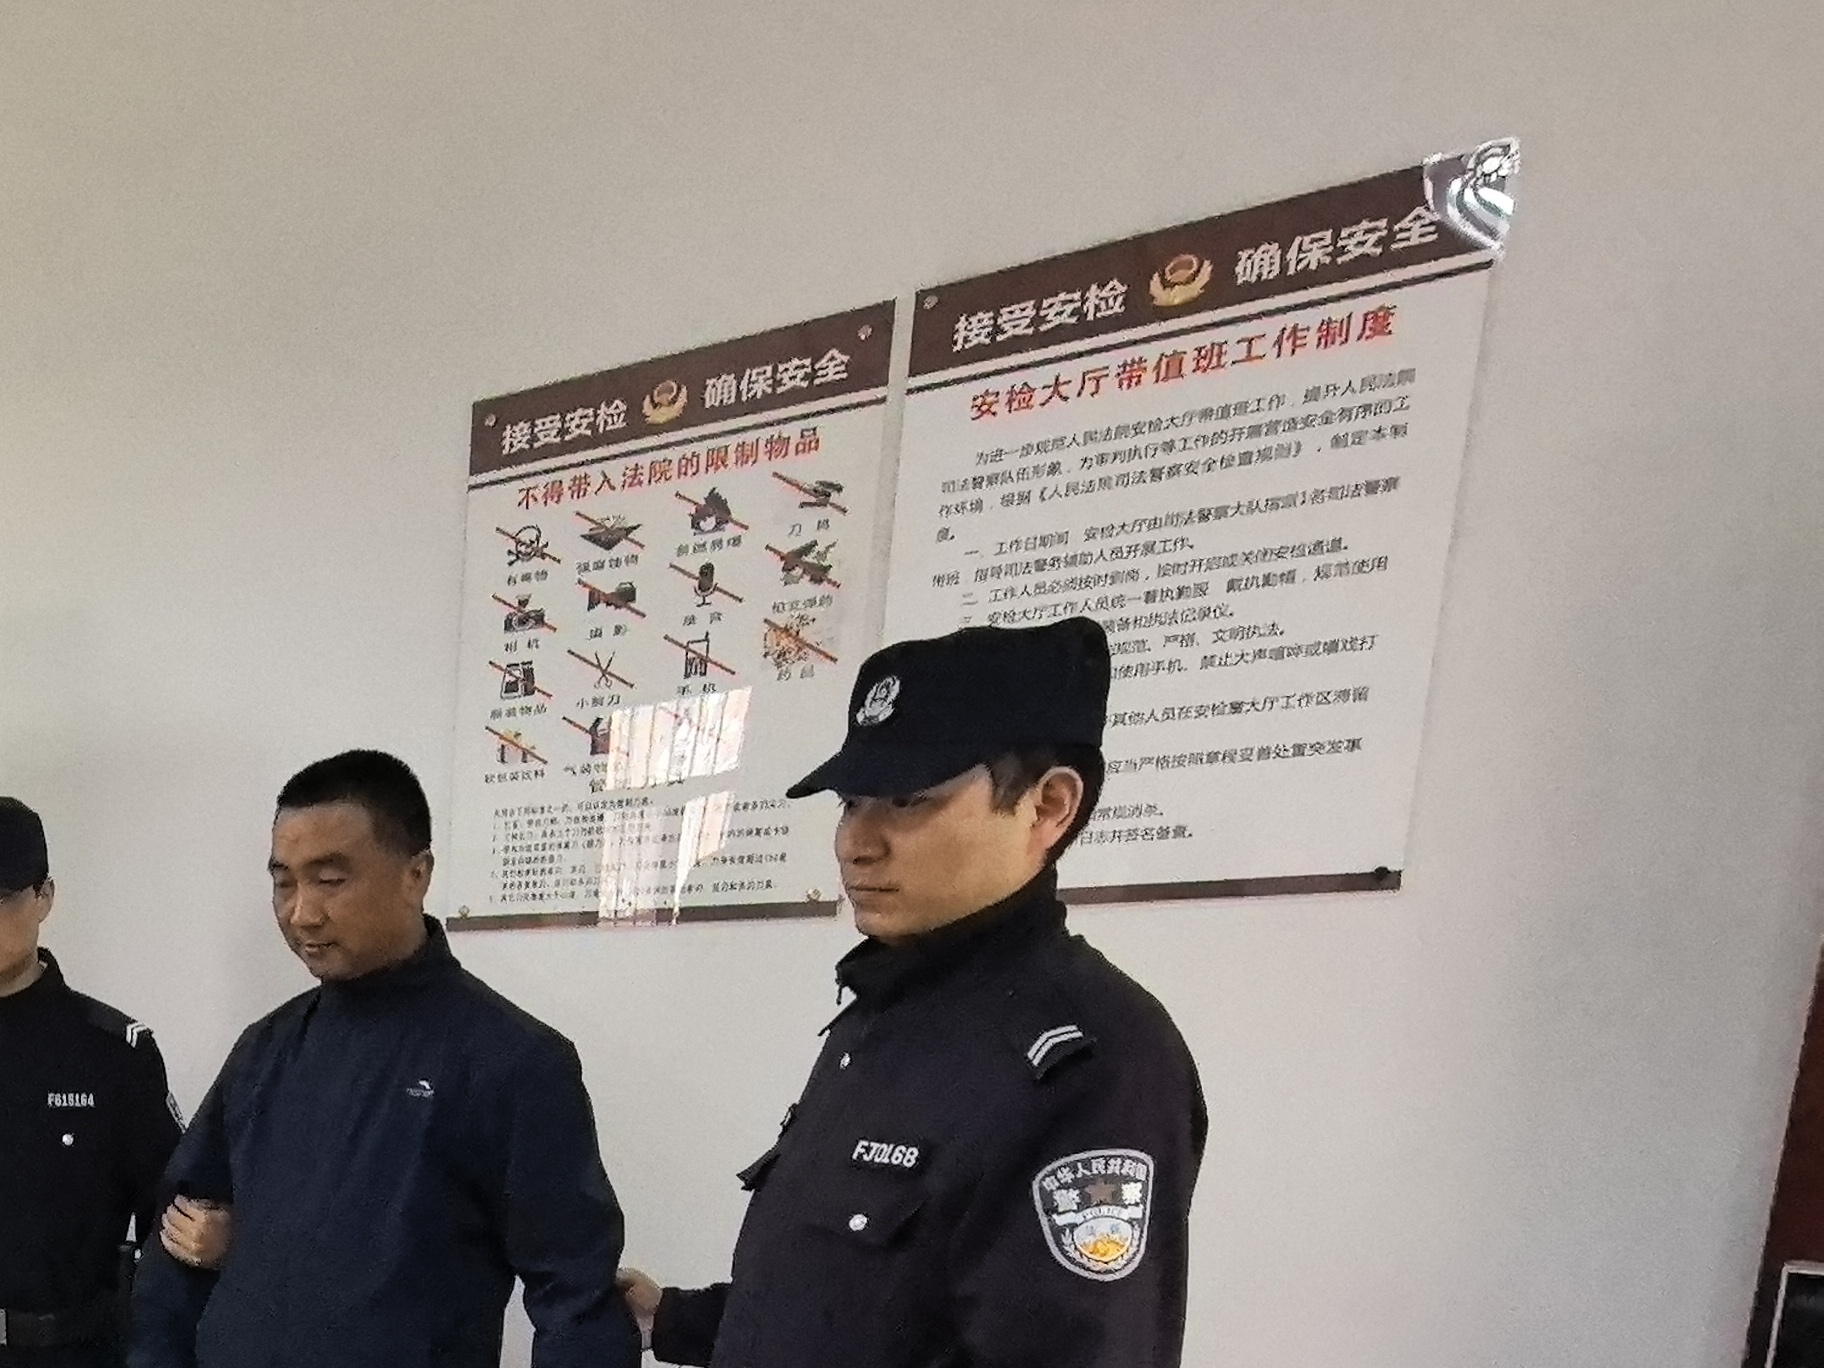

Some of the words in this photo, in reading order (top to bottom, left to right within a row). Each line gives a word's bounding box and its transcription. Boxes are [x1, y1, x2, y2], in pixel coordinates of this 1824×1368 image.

[951, 275, 1130, 353] 接受安检
[1234, 205, 1441, 286] 确保安全
[501, 398, 628, 454] 接受安检
[703, 347, 851, 408] 确保安全
[969, 301, 1400, 422] 安检大厅带值班工作制度
[516, 425, 822, 510] 不得带入法院的限制物品
[852, 1140, 919, 1168] FJ0168
